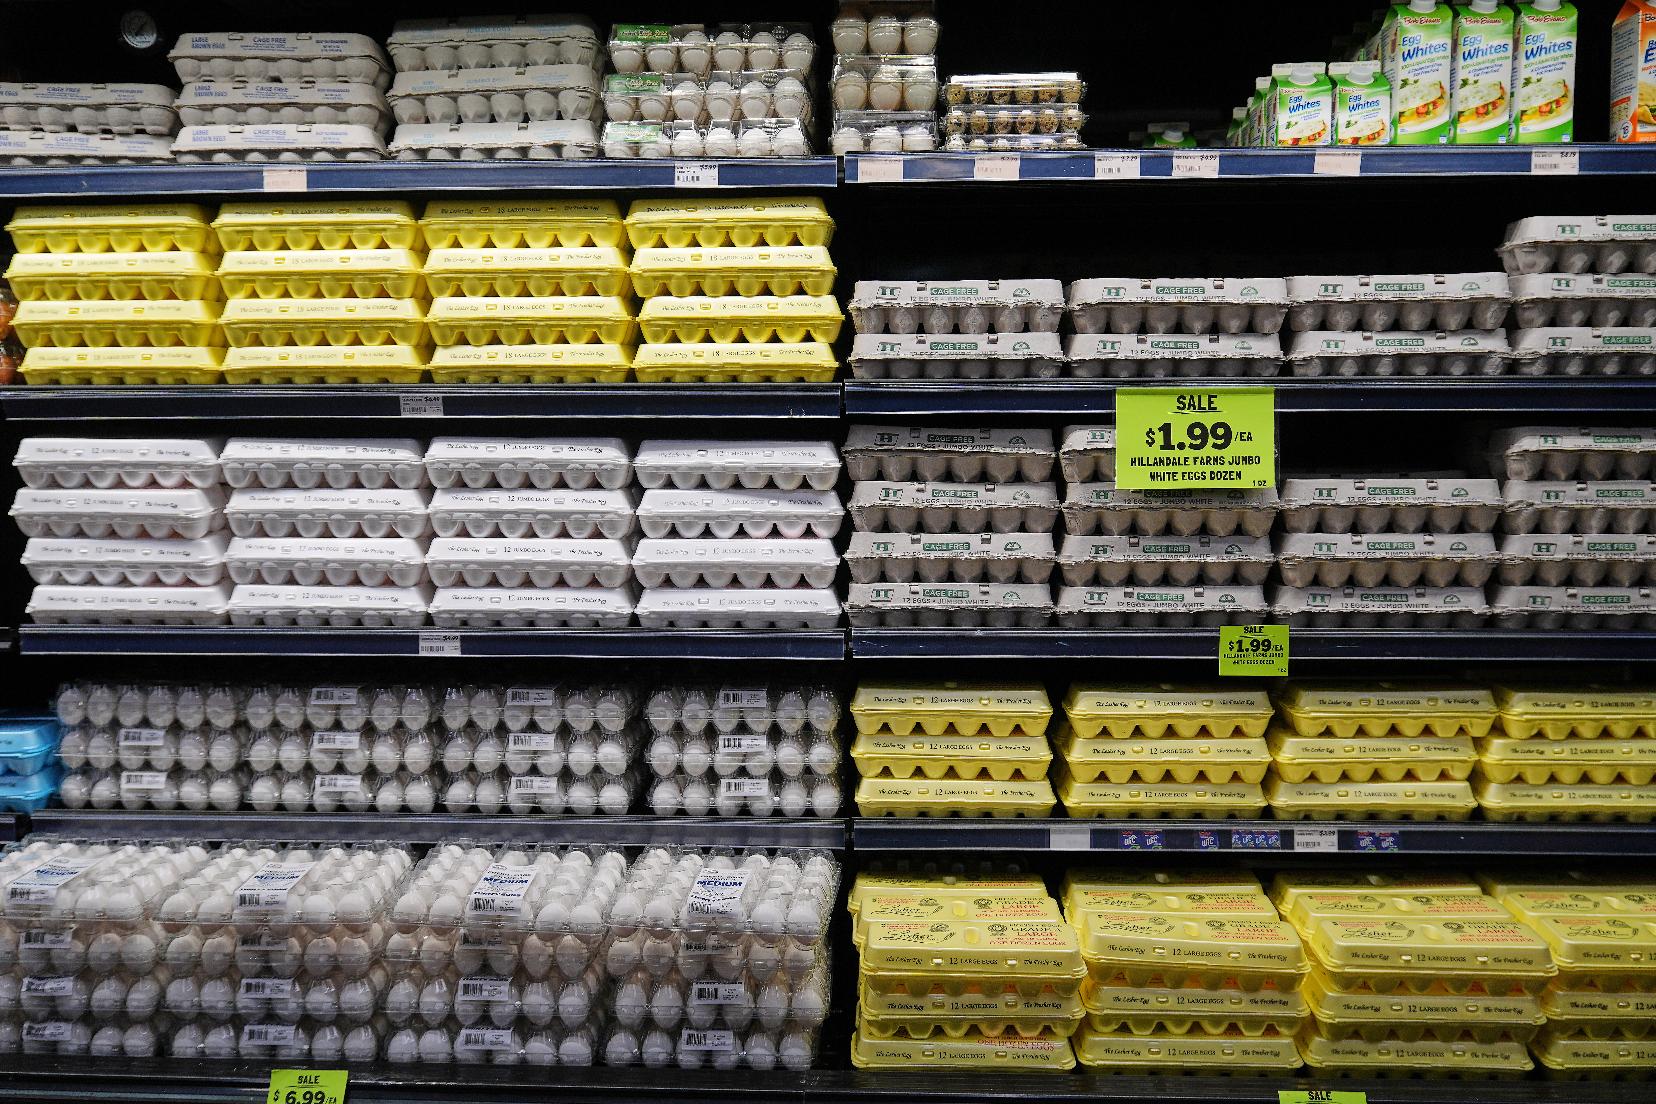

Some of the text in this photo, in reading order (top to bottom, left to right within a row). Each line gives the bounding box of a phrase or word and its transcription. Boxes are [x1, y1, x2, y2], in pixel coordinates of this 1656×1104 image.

[1402, 34, 1421, 47] Egg
[1462, 35, 1482, 47] Egg
[1525, 33, 1545, 46] Egg
[1402, 42, 1448, 62] Whites
[1462, 43, 1509, 62] Whites
[1525, 40, 1572, 61] Whites
[1349, 95, 1362, 103] Egg
[1289, 100, 1320, 113] Whites
[1348, 99, 1380, 113] Whites
[1177, 395, 1218, 410] SALE
[1146, 421, 1232, 451] $1.99
[1131, 456, 1261, 466] HILLANDALE FARMS JUMBO
[1150, 471, 1241, 481] WHITE EGGS DOZEN
[1229, 639, 1272, 652] $1.99
[1202, 837, 1214, 847] WIC
[298, 1076, 320, 1084] SALE
[1308, 1091, 1332, 1101] SALE
